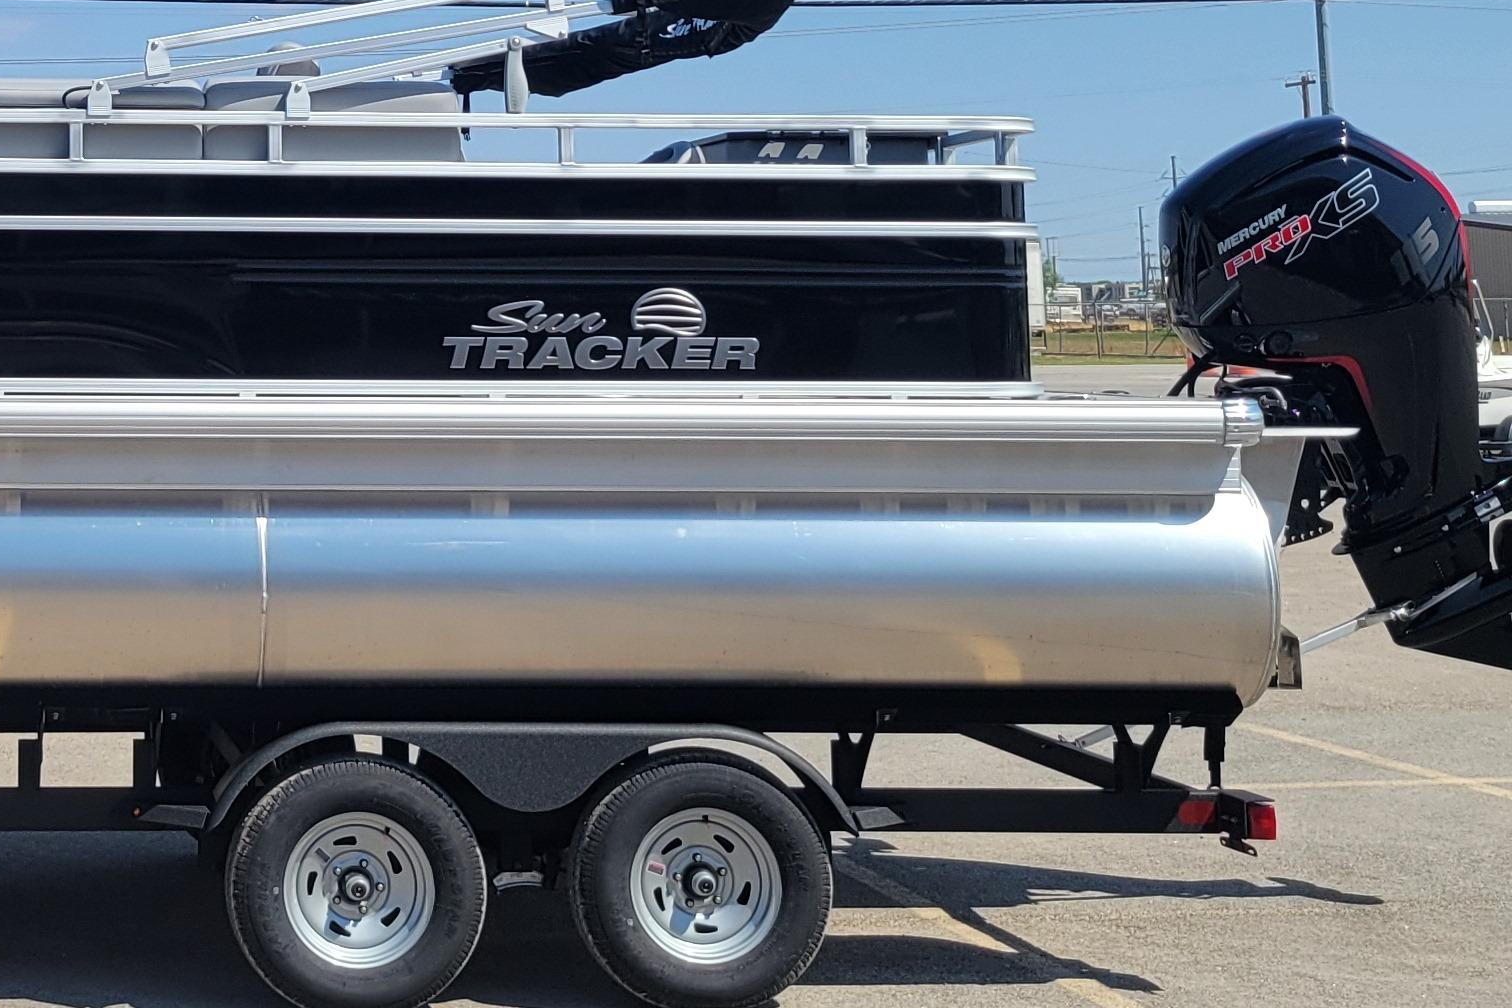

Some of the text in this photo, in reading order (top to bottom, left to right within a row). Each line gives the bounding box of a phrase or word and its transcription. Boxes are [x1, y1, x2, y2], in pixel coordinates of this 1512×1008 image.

[1217, 203, 1287, 255] MERCURY
[1223, 213, 1312, 281] PRO
[471, 299, 607, 334] Sun
[442, 335, 761, 371] TRACKER
